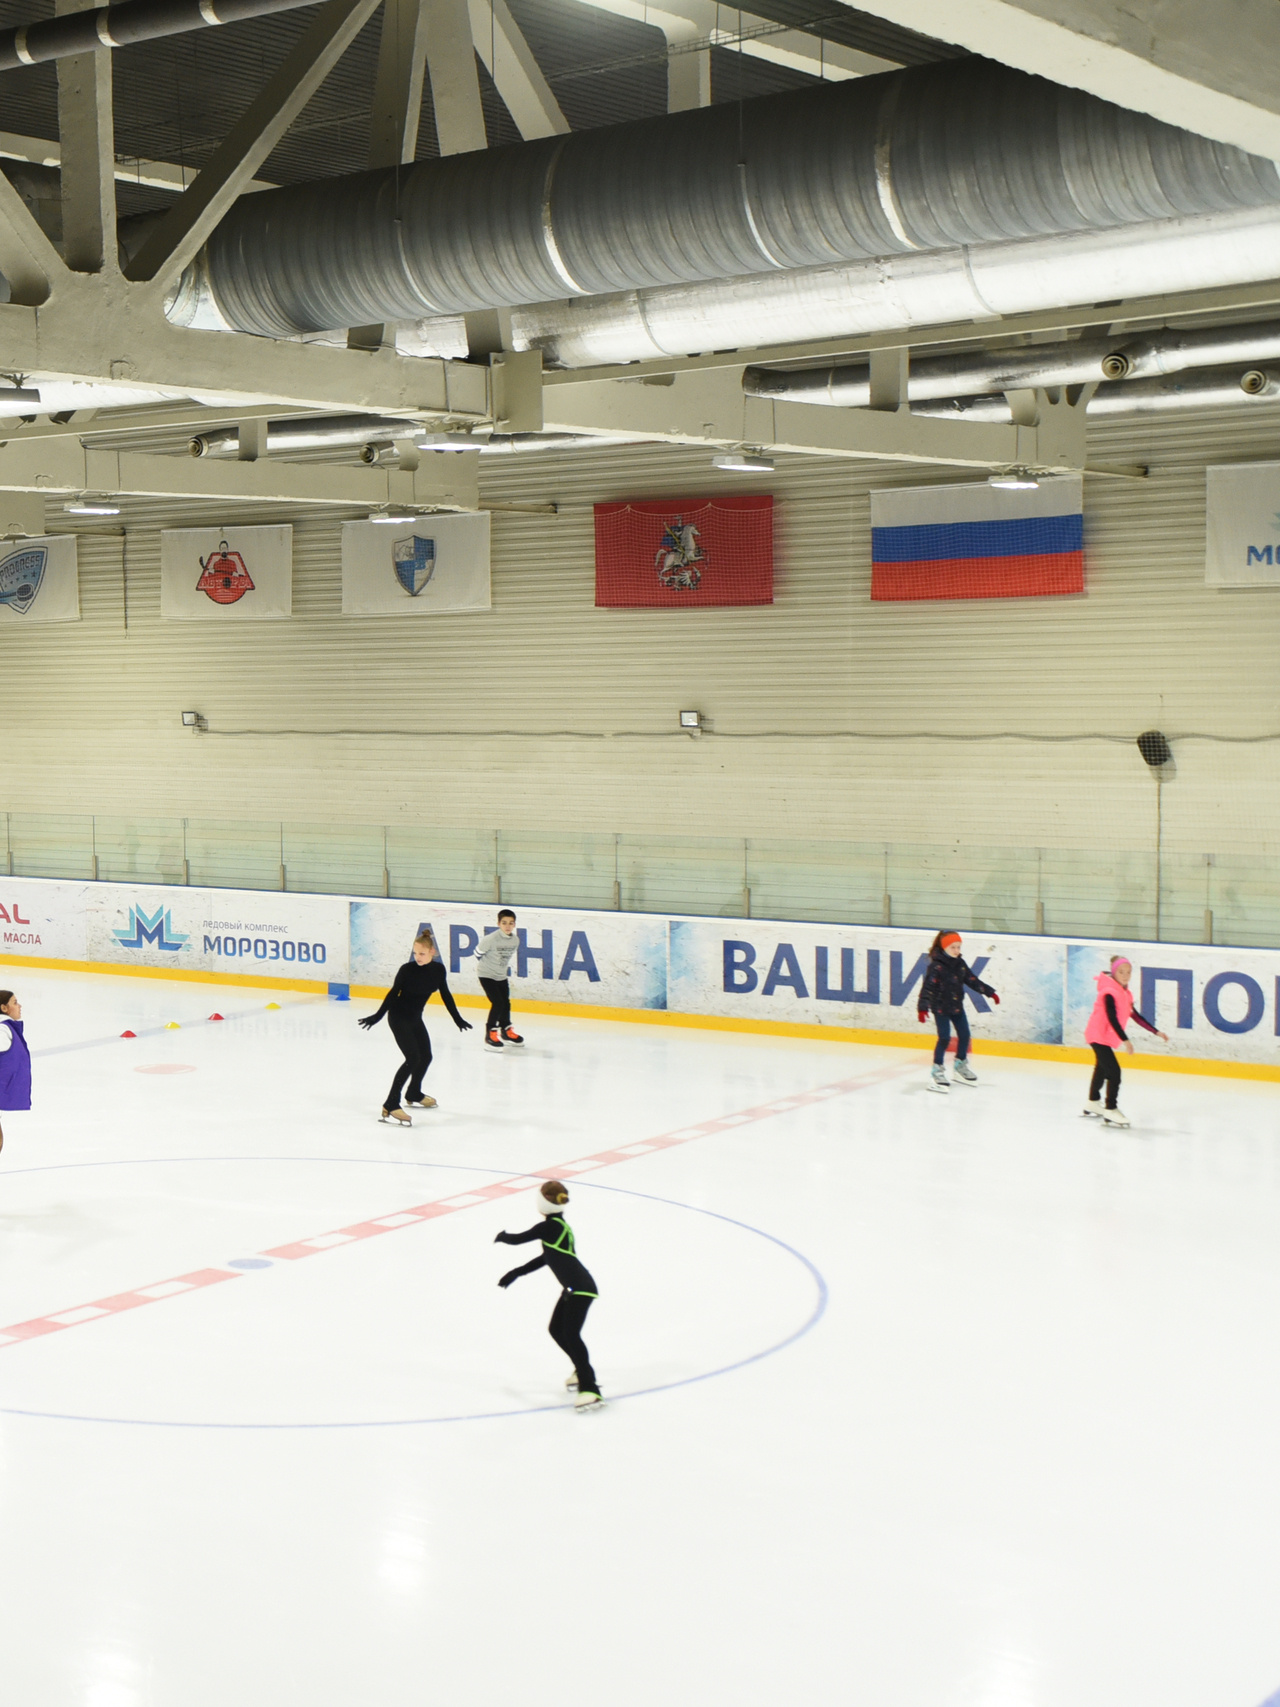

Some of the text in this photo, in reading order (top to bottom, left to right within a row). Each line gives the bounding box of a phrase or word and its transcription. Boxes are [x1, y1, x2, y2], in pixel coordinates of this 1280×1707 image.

[202, 920, 289, 934] ледовый комплекс
[3, 932, 42, 945] МАСЛА
[203, 935, 326, 964] МОРОЗОВО
[409, 922, 601, 982] АРНА
